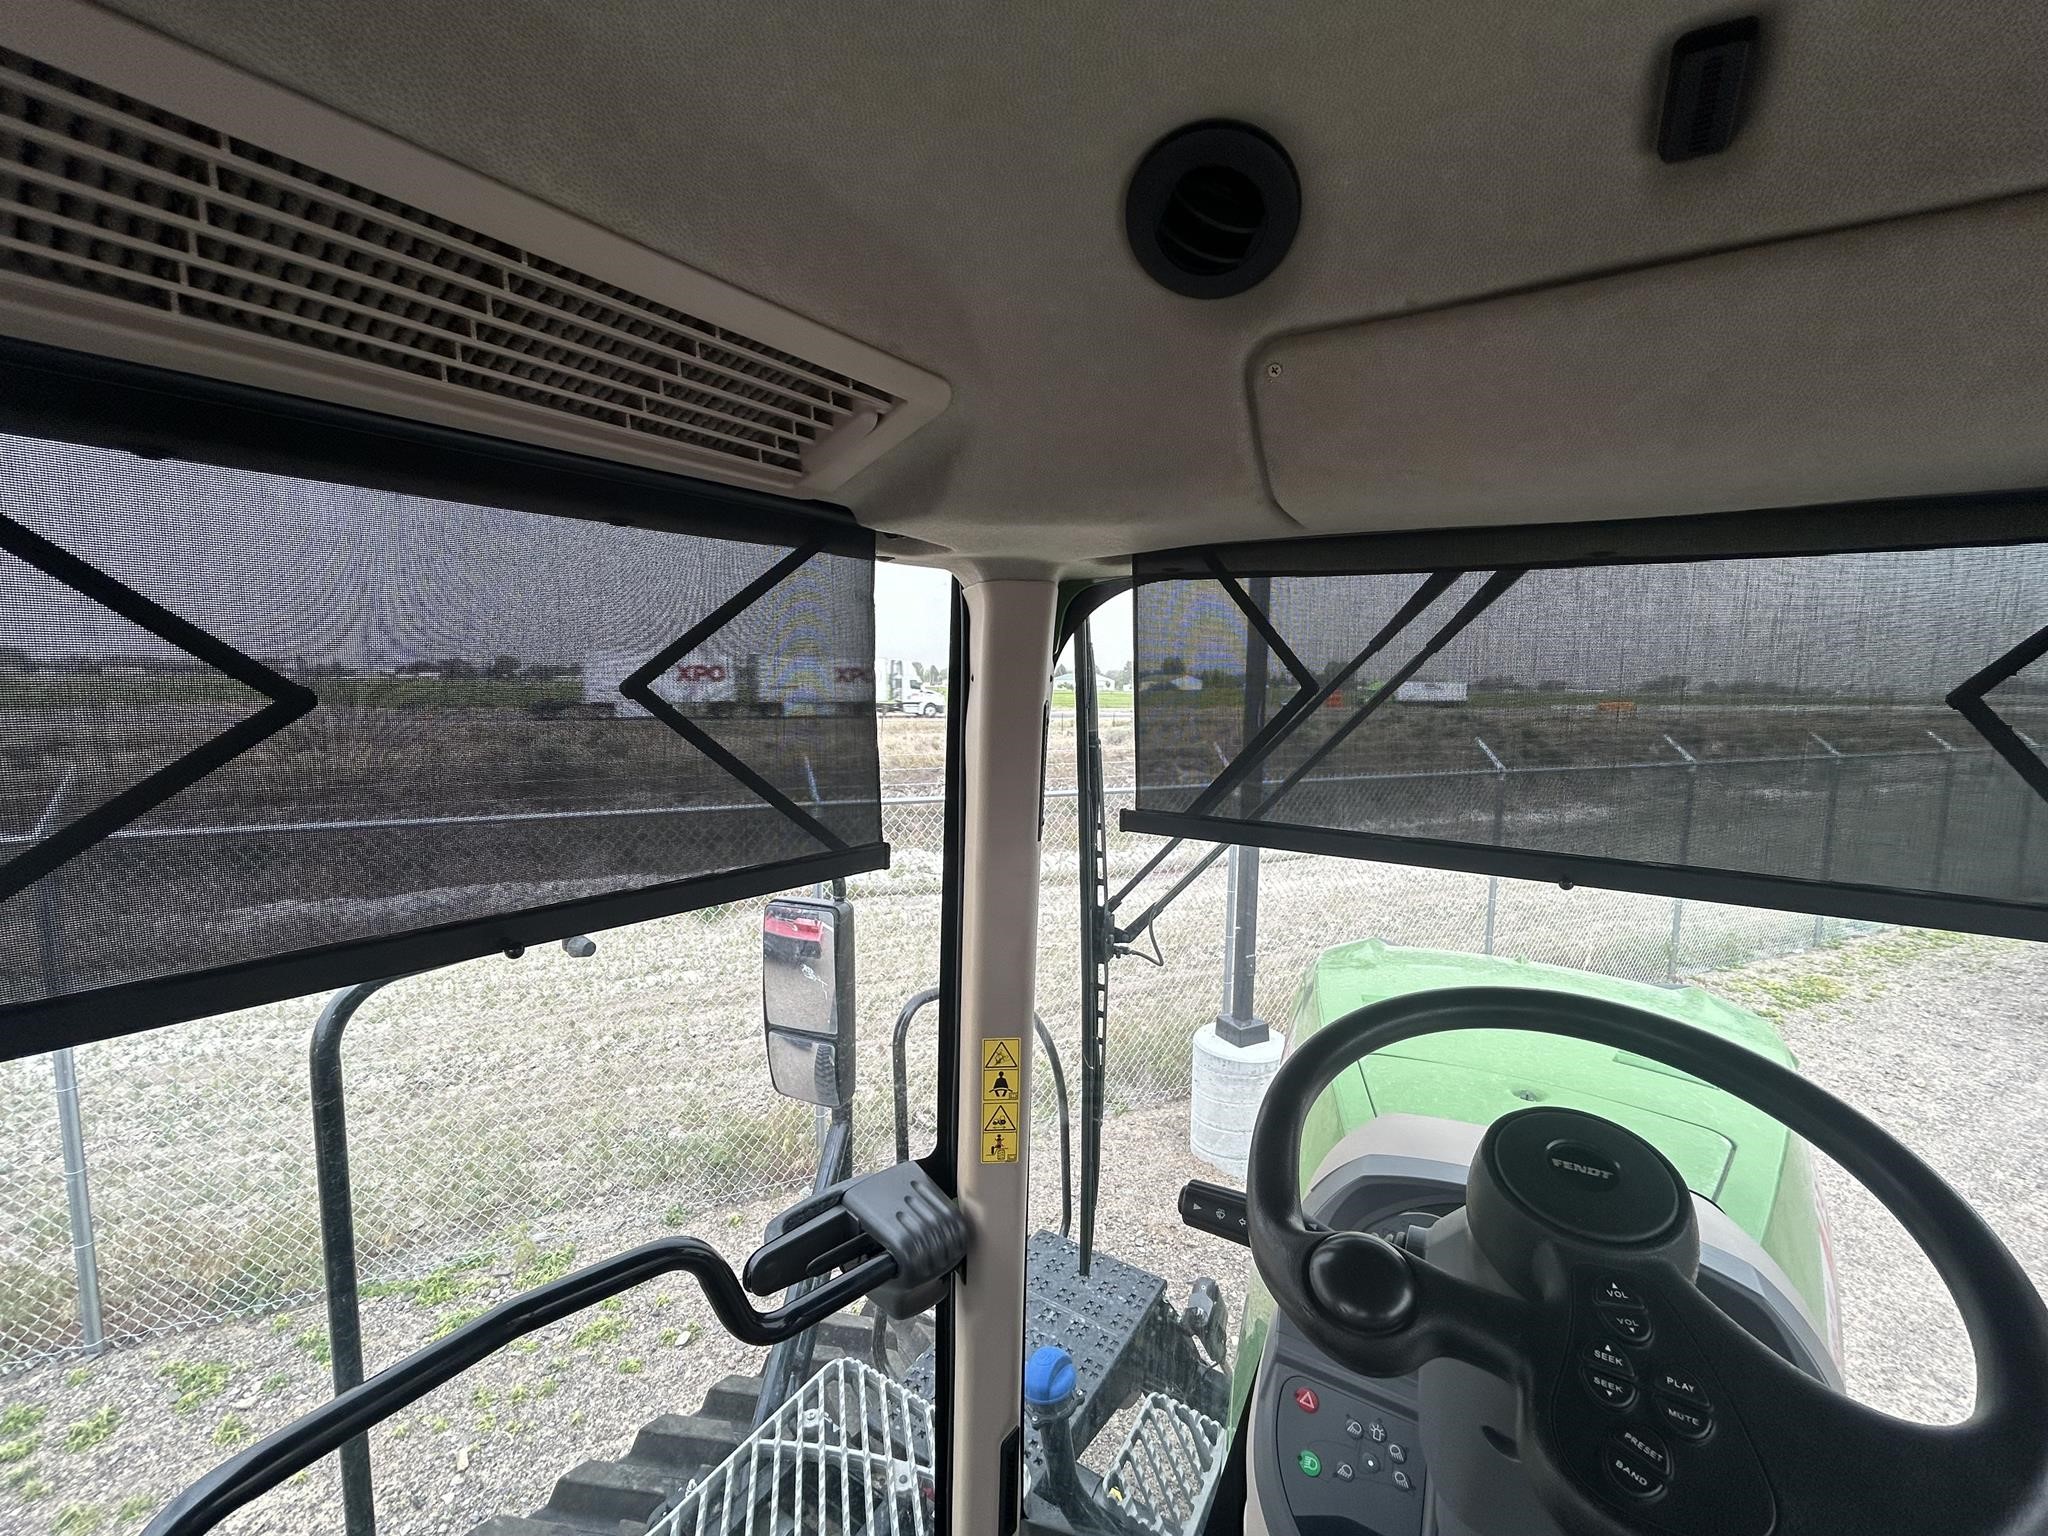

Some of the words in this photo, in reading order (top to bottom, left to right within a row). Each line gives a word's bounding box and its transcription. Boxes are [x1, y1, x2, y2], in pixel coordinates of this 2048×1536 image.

[676, 664, 726, 682] XPO
[1551, 1157, 1615, 1181] FENDT
[1606, 1286, 1629, 1301] VOL
[1616, 1315, 1640, 1329] VOL
[1593, 1348, 1624, 1367] SEEK
[1592, 1375, 1624, 1394] SEEK
[1666, 1375, 1696, 1393] PLAY
[1667, 1406, 1700, 1426] MUTE
[1623, 1431, 1664, 1463] PRESET
[1615, 1458, 1648, 1487] BAND
